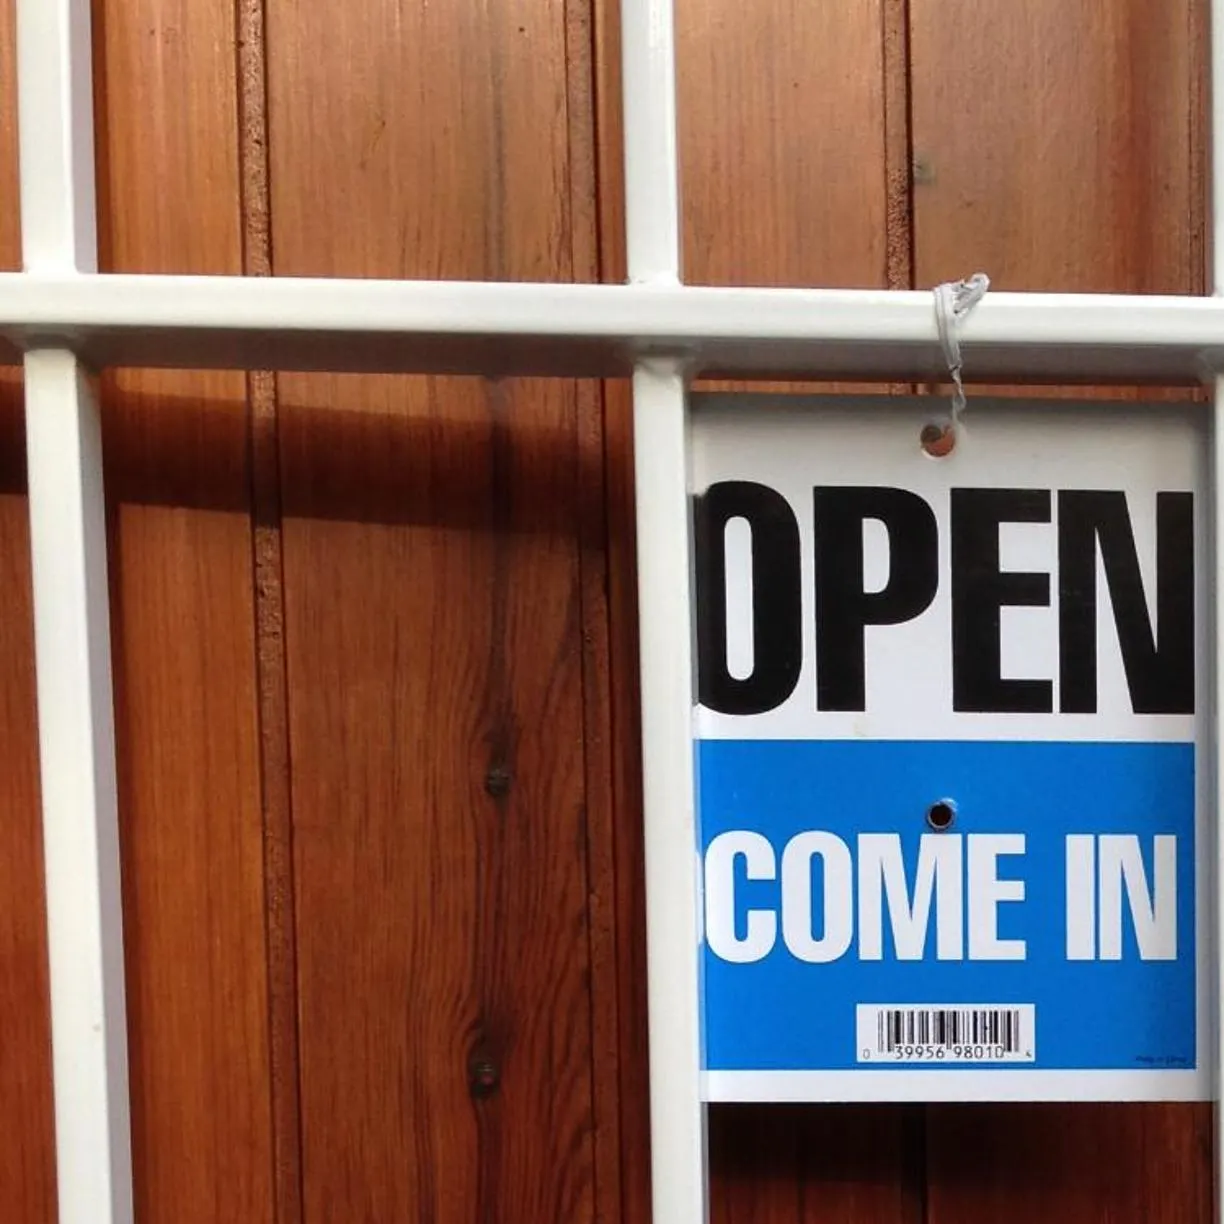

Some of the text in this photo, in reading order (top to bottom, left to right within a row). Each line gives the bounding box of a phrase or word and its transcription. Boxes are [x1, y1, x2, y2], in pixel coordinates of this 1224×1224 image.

[695, 480, 1195, 715] OPEN
[704, 830, 1177, 963] COME IN
[895, 1045, 946, 1060] 39956
[953, 1045, 1005, 1060] 98010
